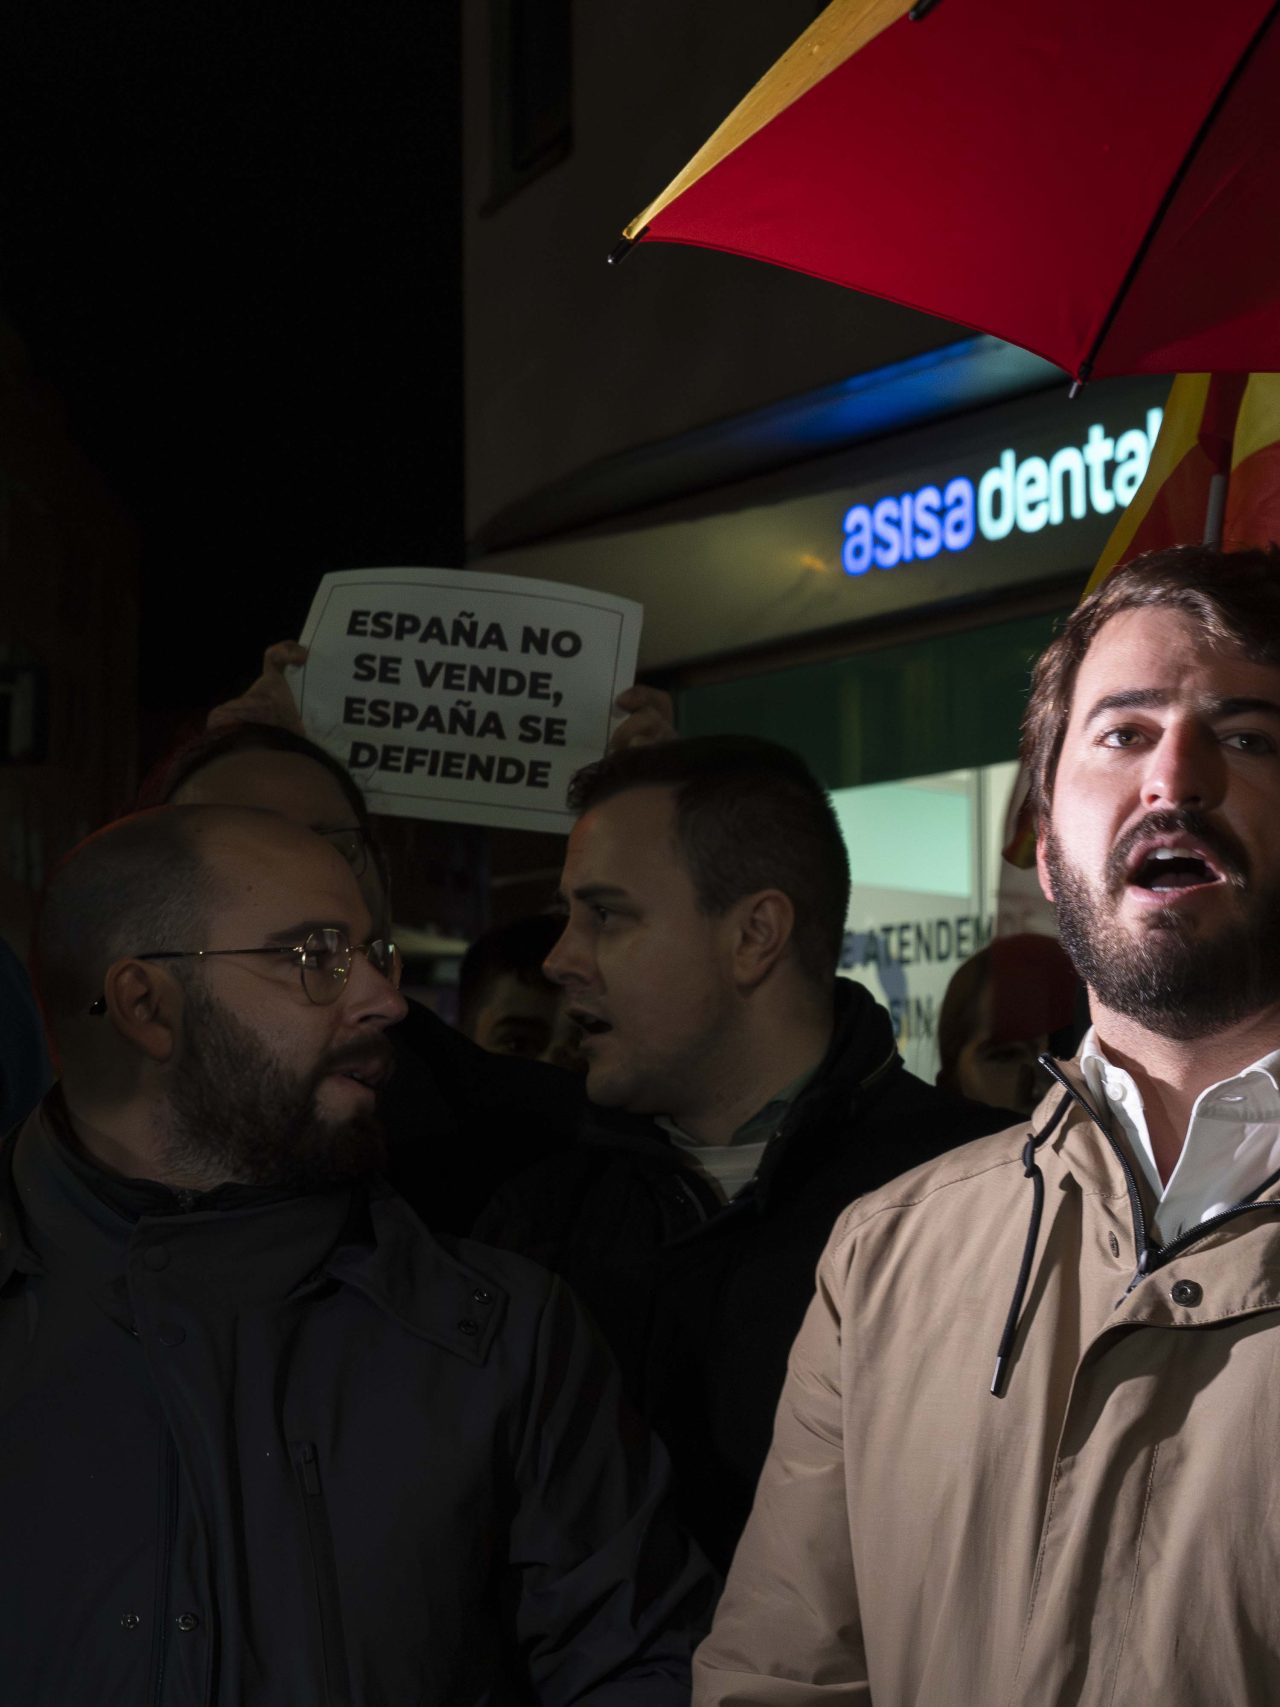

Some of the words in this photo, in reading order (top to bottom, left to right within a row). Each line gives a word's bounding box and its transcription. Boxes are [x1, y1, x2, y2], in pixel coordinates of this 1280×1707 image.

[346, 610, 508, 653] ESPAÑA
[520, 626, 583, 659] NO
[351, 653, 403, 685] SE
[414, 659, 564, 708] VENDE,
[342, 696, 507, 741] ESPAÑA
[517, 714, 568, 747] SE
[347, 741, 553, 789] DEFIENDE
